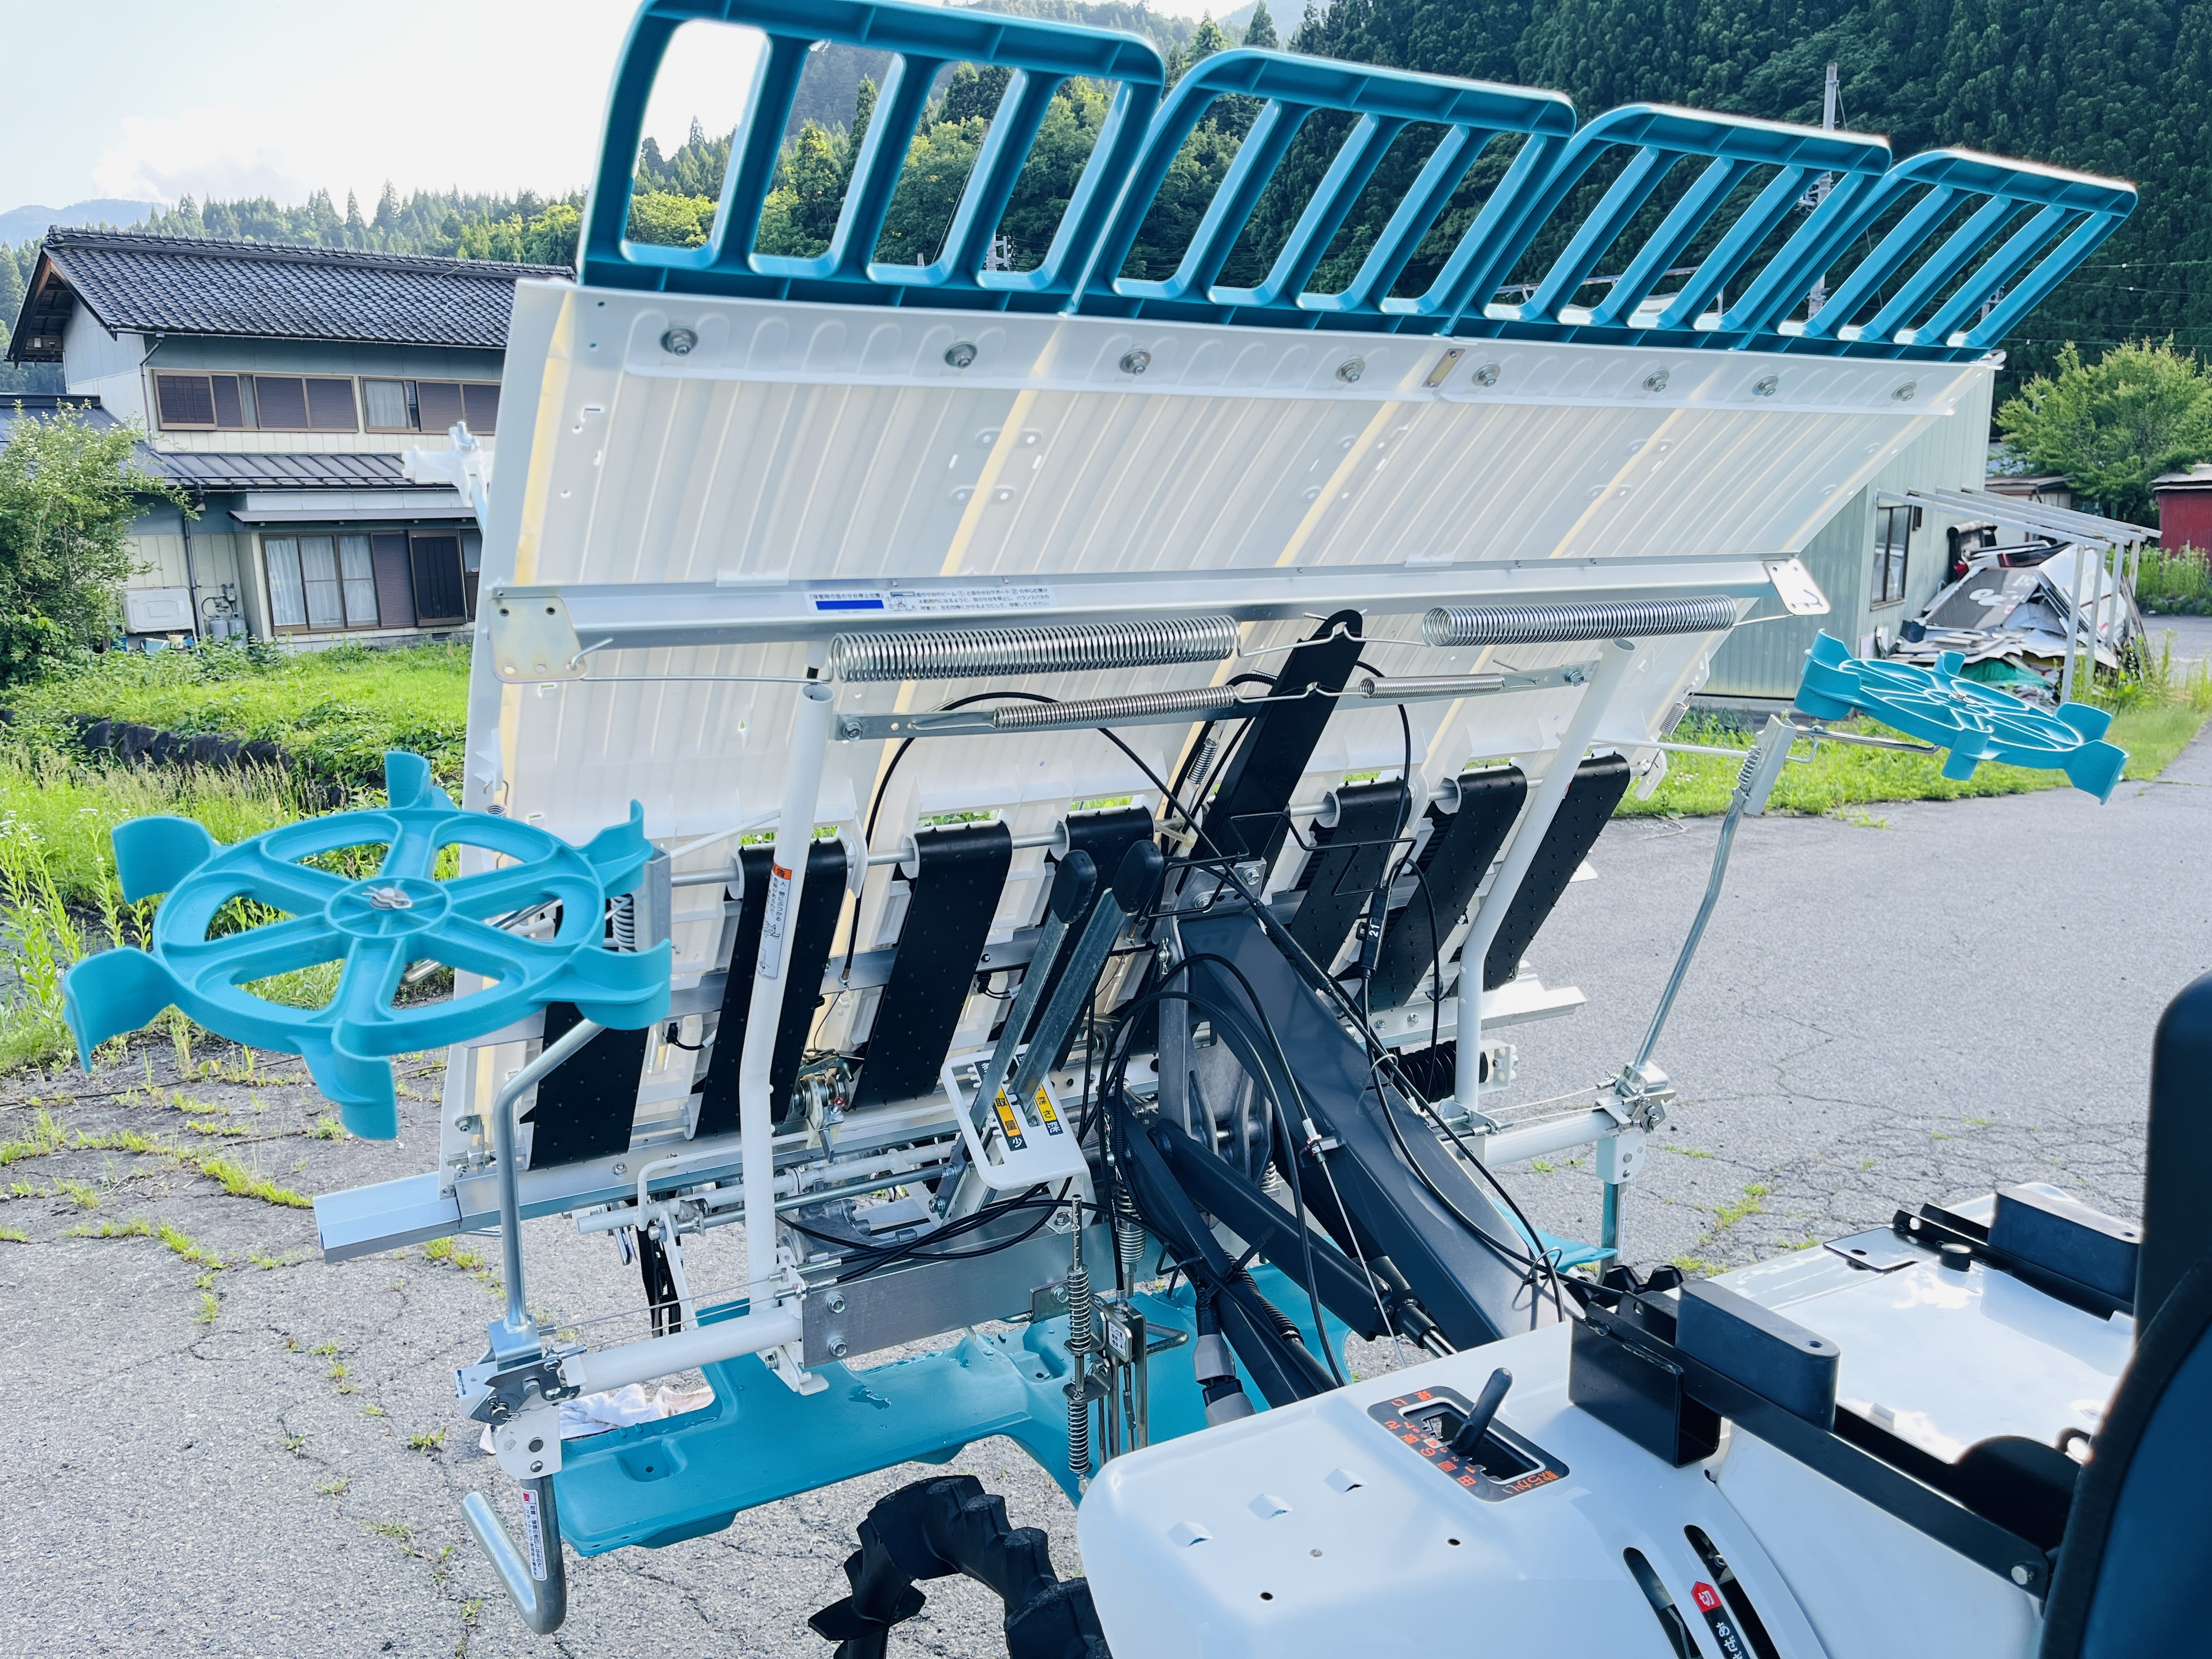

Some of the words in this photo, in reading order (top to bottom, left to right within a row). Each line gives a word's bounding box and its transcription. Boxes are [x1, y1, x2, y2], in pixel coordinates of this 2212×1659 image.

[1369, 924, 1380, 937] 21
[1037, 1089, 1052, 1118] 深さ
[995, 1098, 1017, 1131] 取量
[1047, 1121, 1060, 1133] 深
[1012, 1137, 1022, 1148] 少
[1502, 1471, 1558, 1494] 軟らかい
[1698, 1590, 1714, 1606] 切
